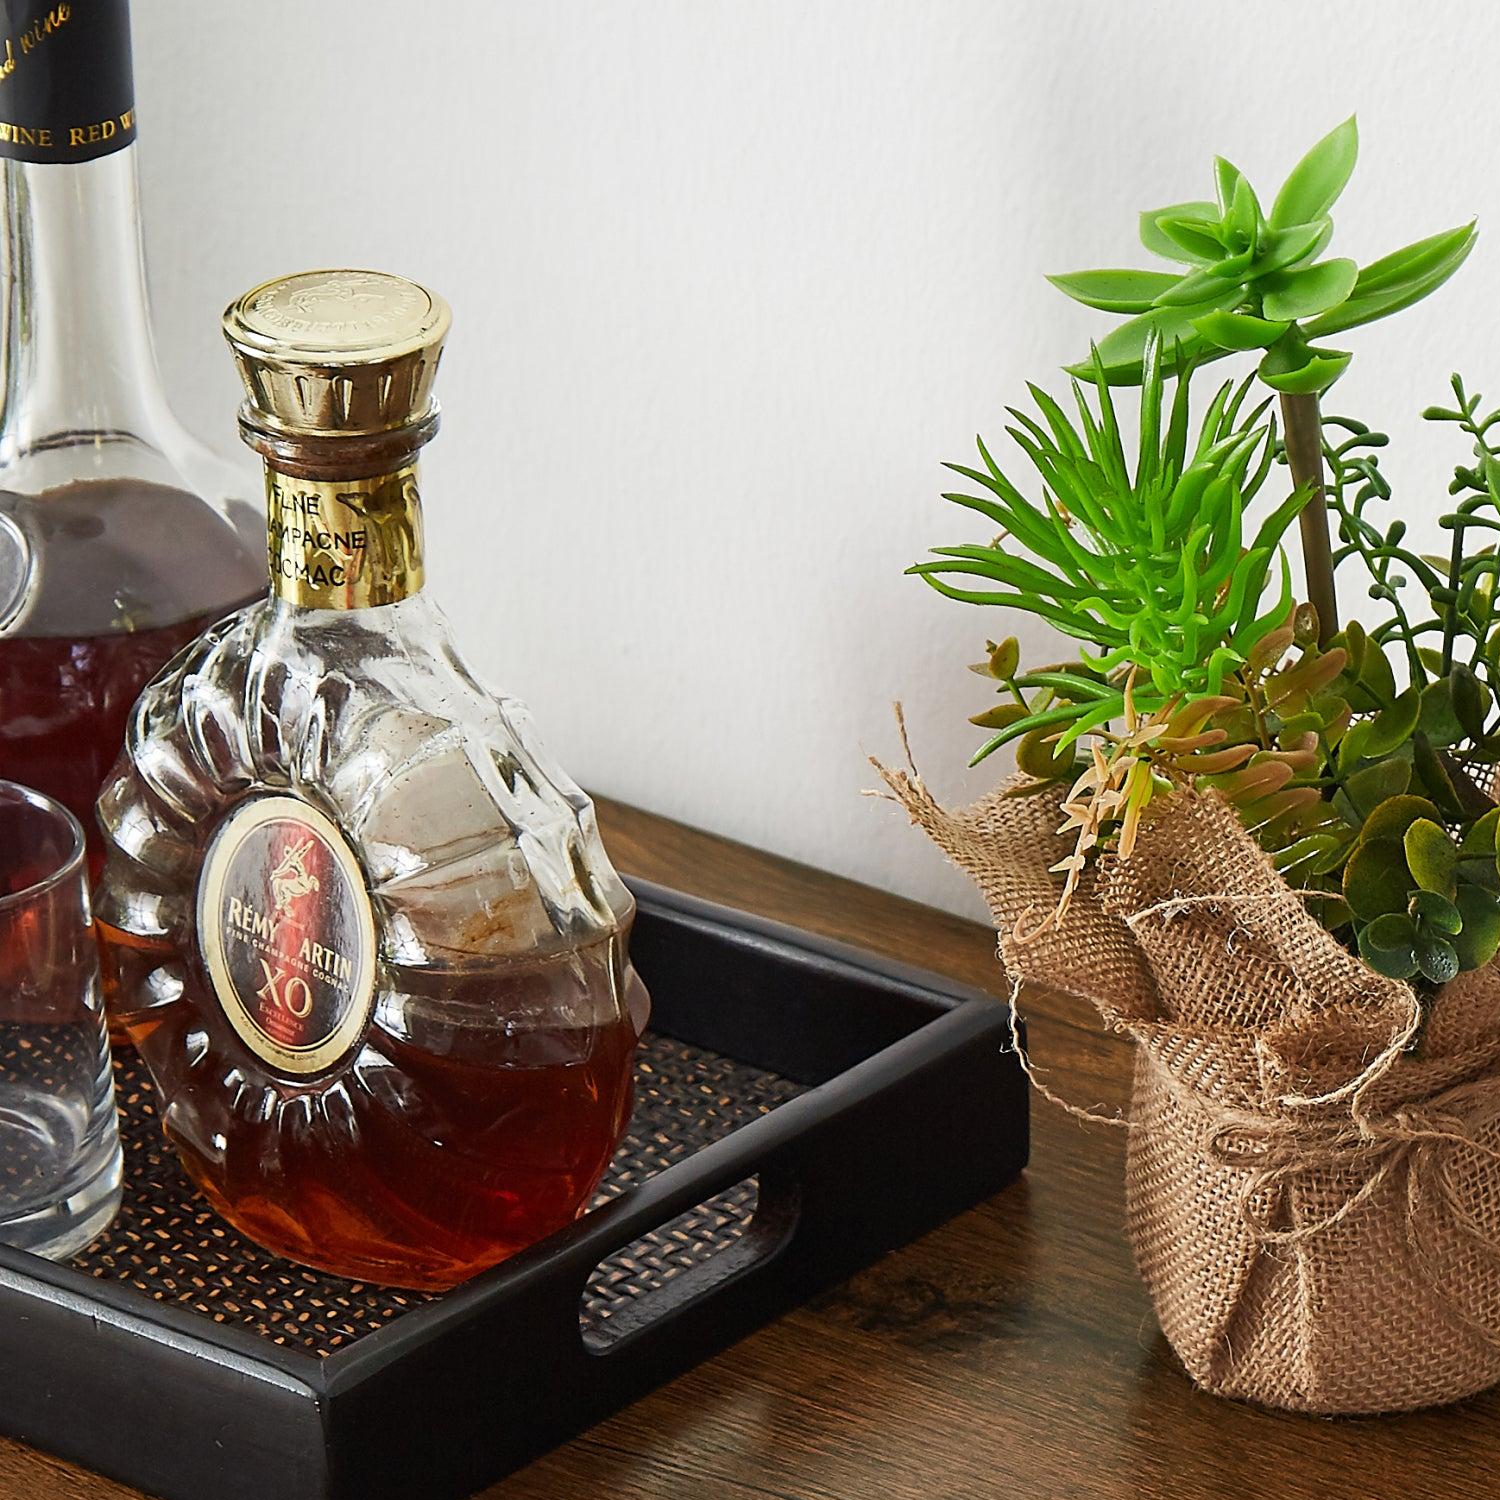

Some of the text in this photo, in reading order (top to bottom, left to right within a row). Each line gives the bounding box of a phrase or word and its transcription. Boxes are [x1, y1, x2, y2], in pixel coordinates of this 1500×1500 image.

[20, 2, 71, 54] wine
[0, 121, 53, 147] WINE
[69, 120, 116, 146] RED
[227, 896, 353, 983] RÉMY ARTIN
[251, 938, 310, 974] CHAMPAGNE
[256, 958, 314, 1019] XO
